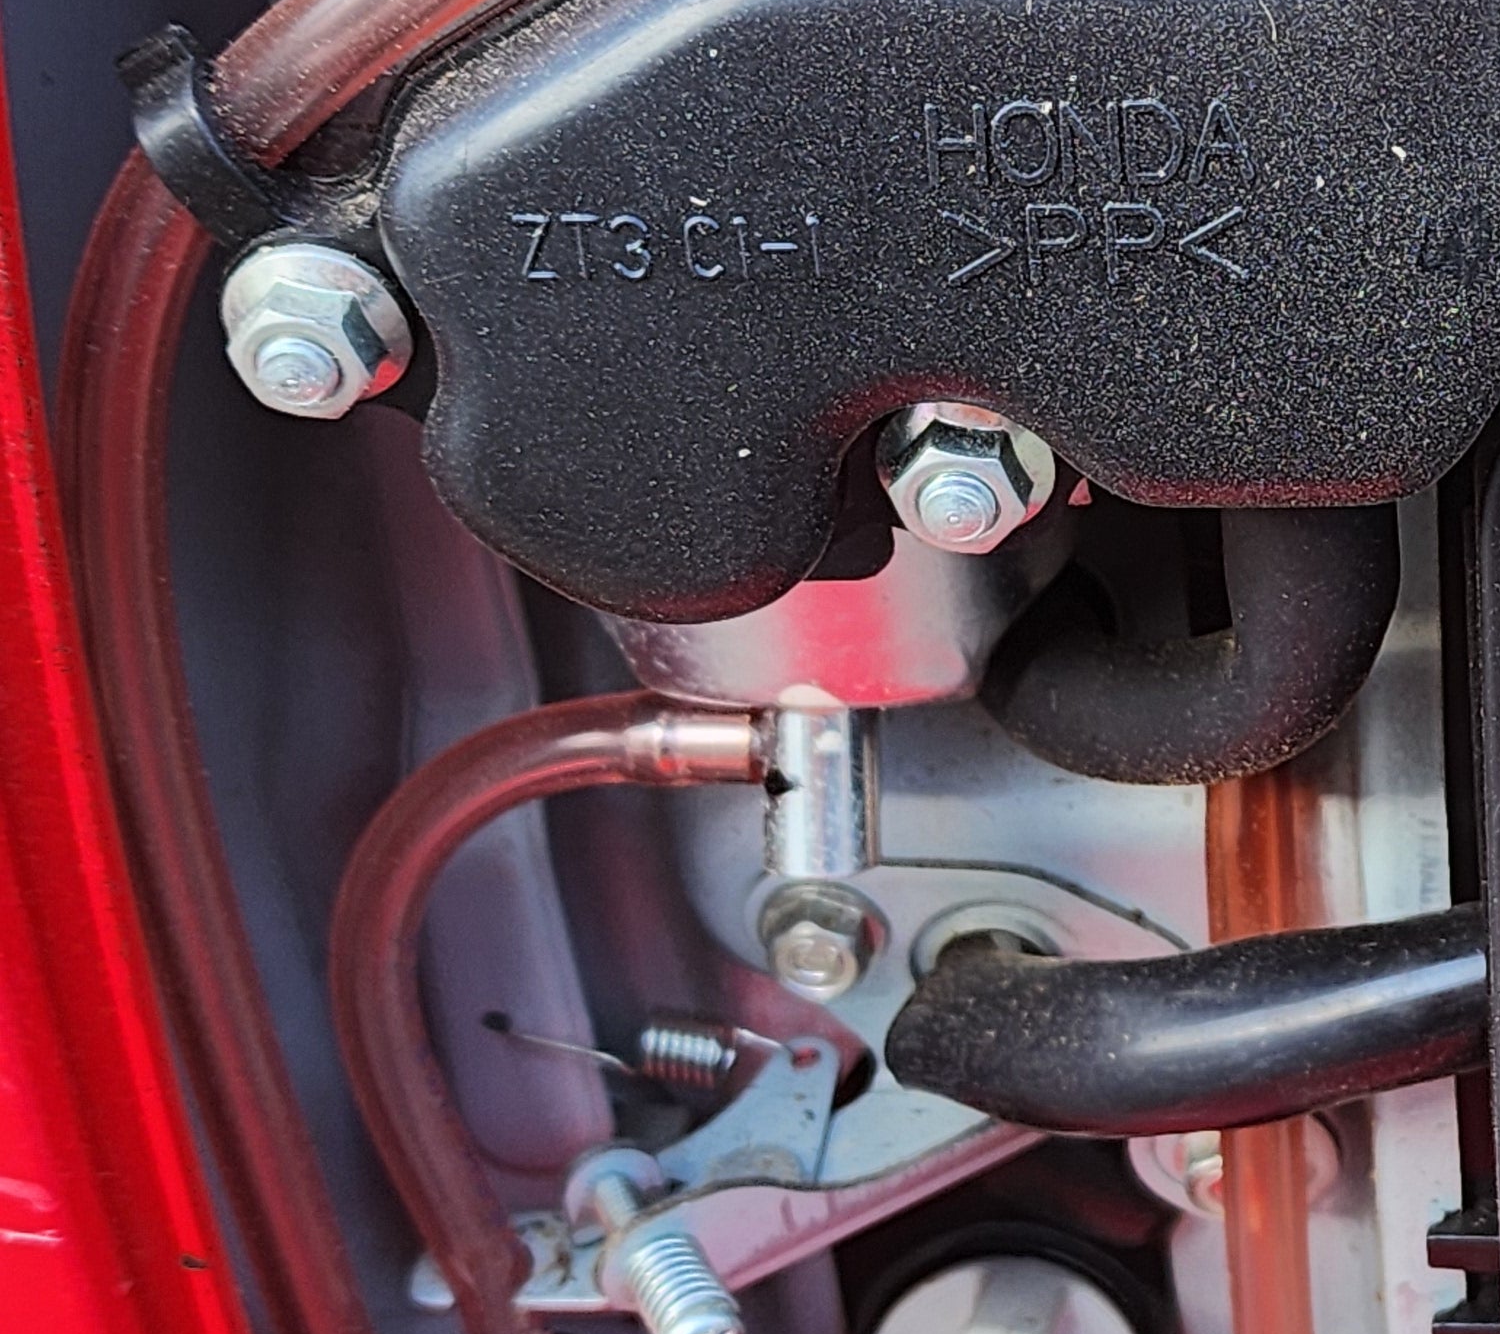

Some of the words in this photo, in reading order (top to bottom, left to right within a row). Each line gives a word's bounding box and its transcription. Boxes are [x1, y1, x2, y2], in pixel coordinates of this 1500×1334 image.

[922, 98, 1256, 190] HONDA
[511, 211, 655, 282] ZT3
[939, 200, 1254, 288] >PP<
